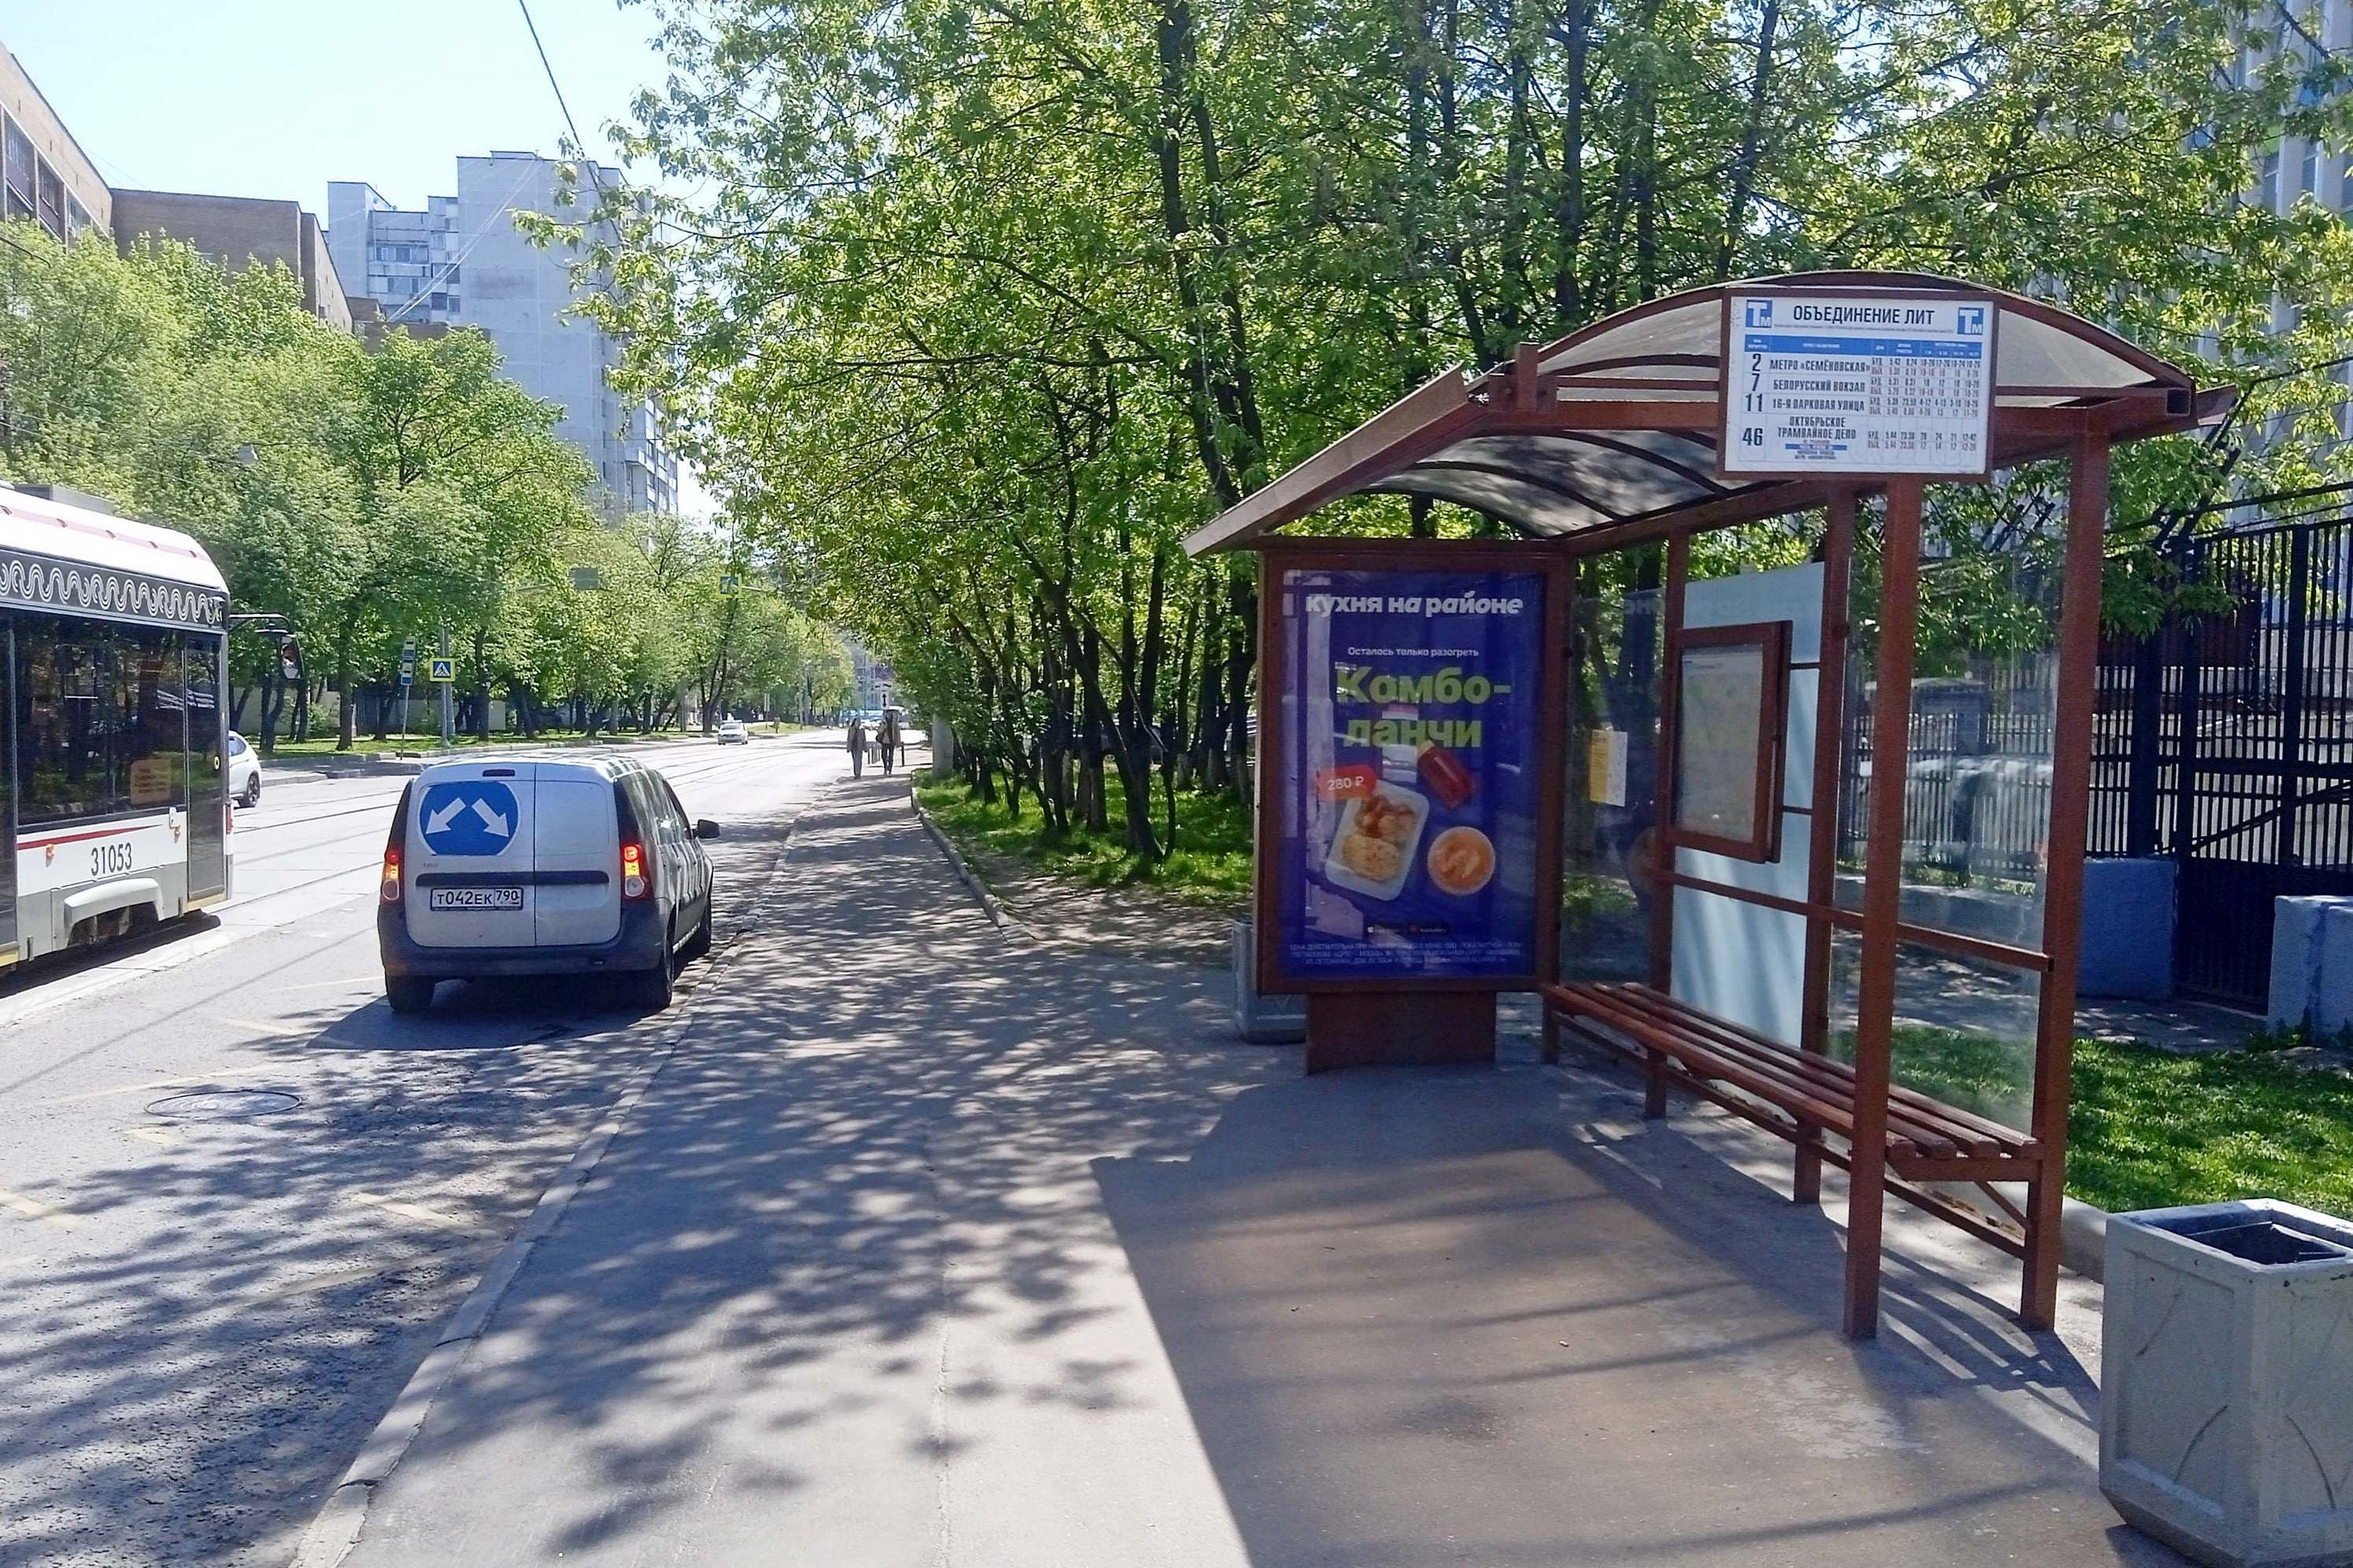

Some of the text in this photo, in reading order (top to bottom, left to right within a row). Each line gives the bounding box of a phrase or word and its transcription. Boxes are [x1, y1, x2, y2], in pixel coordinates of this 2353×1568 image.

[1793, 305, 1935, 325] ОБЪЕДИНЕНИЕ ЛИТ
[1752, 353, 1761, 371] 2
[1770, 360, 1798, 370] МЕТРО
[1752, 373, 1760, 391] 7
[1773, 379, 1865, 392] БЕЛОРУССКИЙ ВОКЗАЛ
[1745, 393, 1762, 411] 11
[1773, 398, 1864, 412] 16-Я ПАРКОВАЯ УЛИЦА
[1790, 416, 1845, 427] ОКТЯБРЬСКОЕ
[1742, 428, 1763, 446] 46
[1778, 427, 1856, 440] ТРАМВАЙНОЕ ДЕПО
[1388, 597, 1421, 614] на
[1426, 591, 1524, 618] районе
[1347, 647, 1479, 659] Осталось только разогреть
[1336, 666, 1511, 705] Комбо-
[1343, 719, 1482, 748] ланчи
[90, 842, 132, 876] 31053
[438, 891, 493, 905] Т042ЕК
